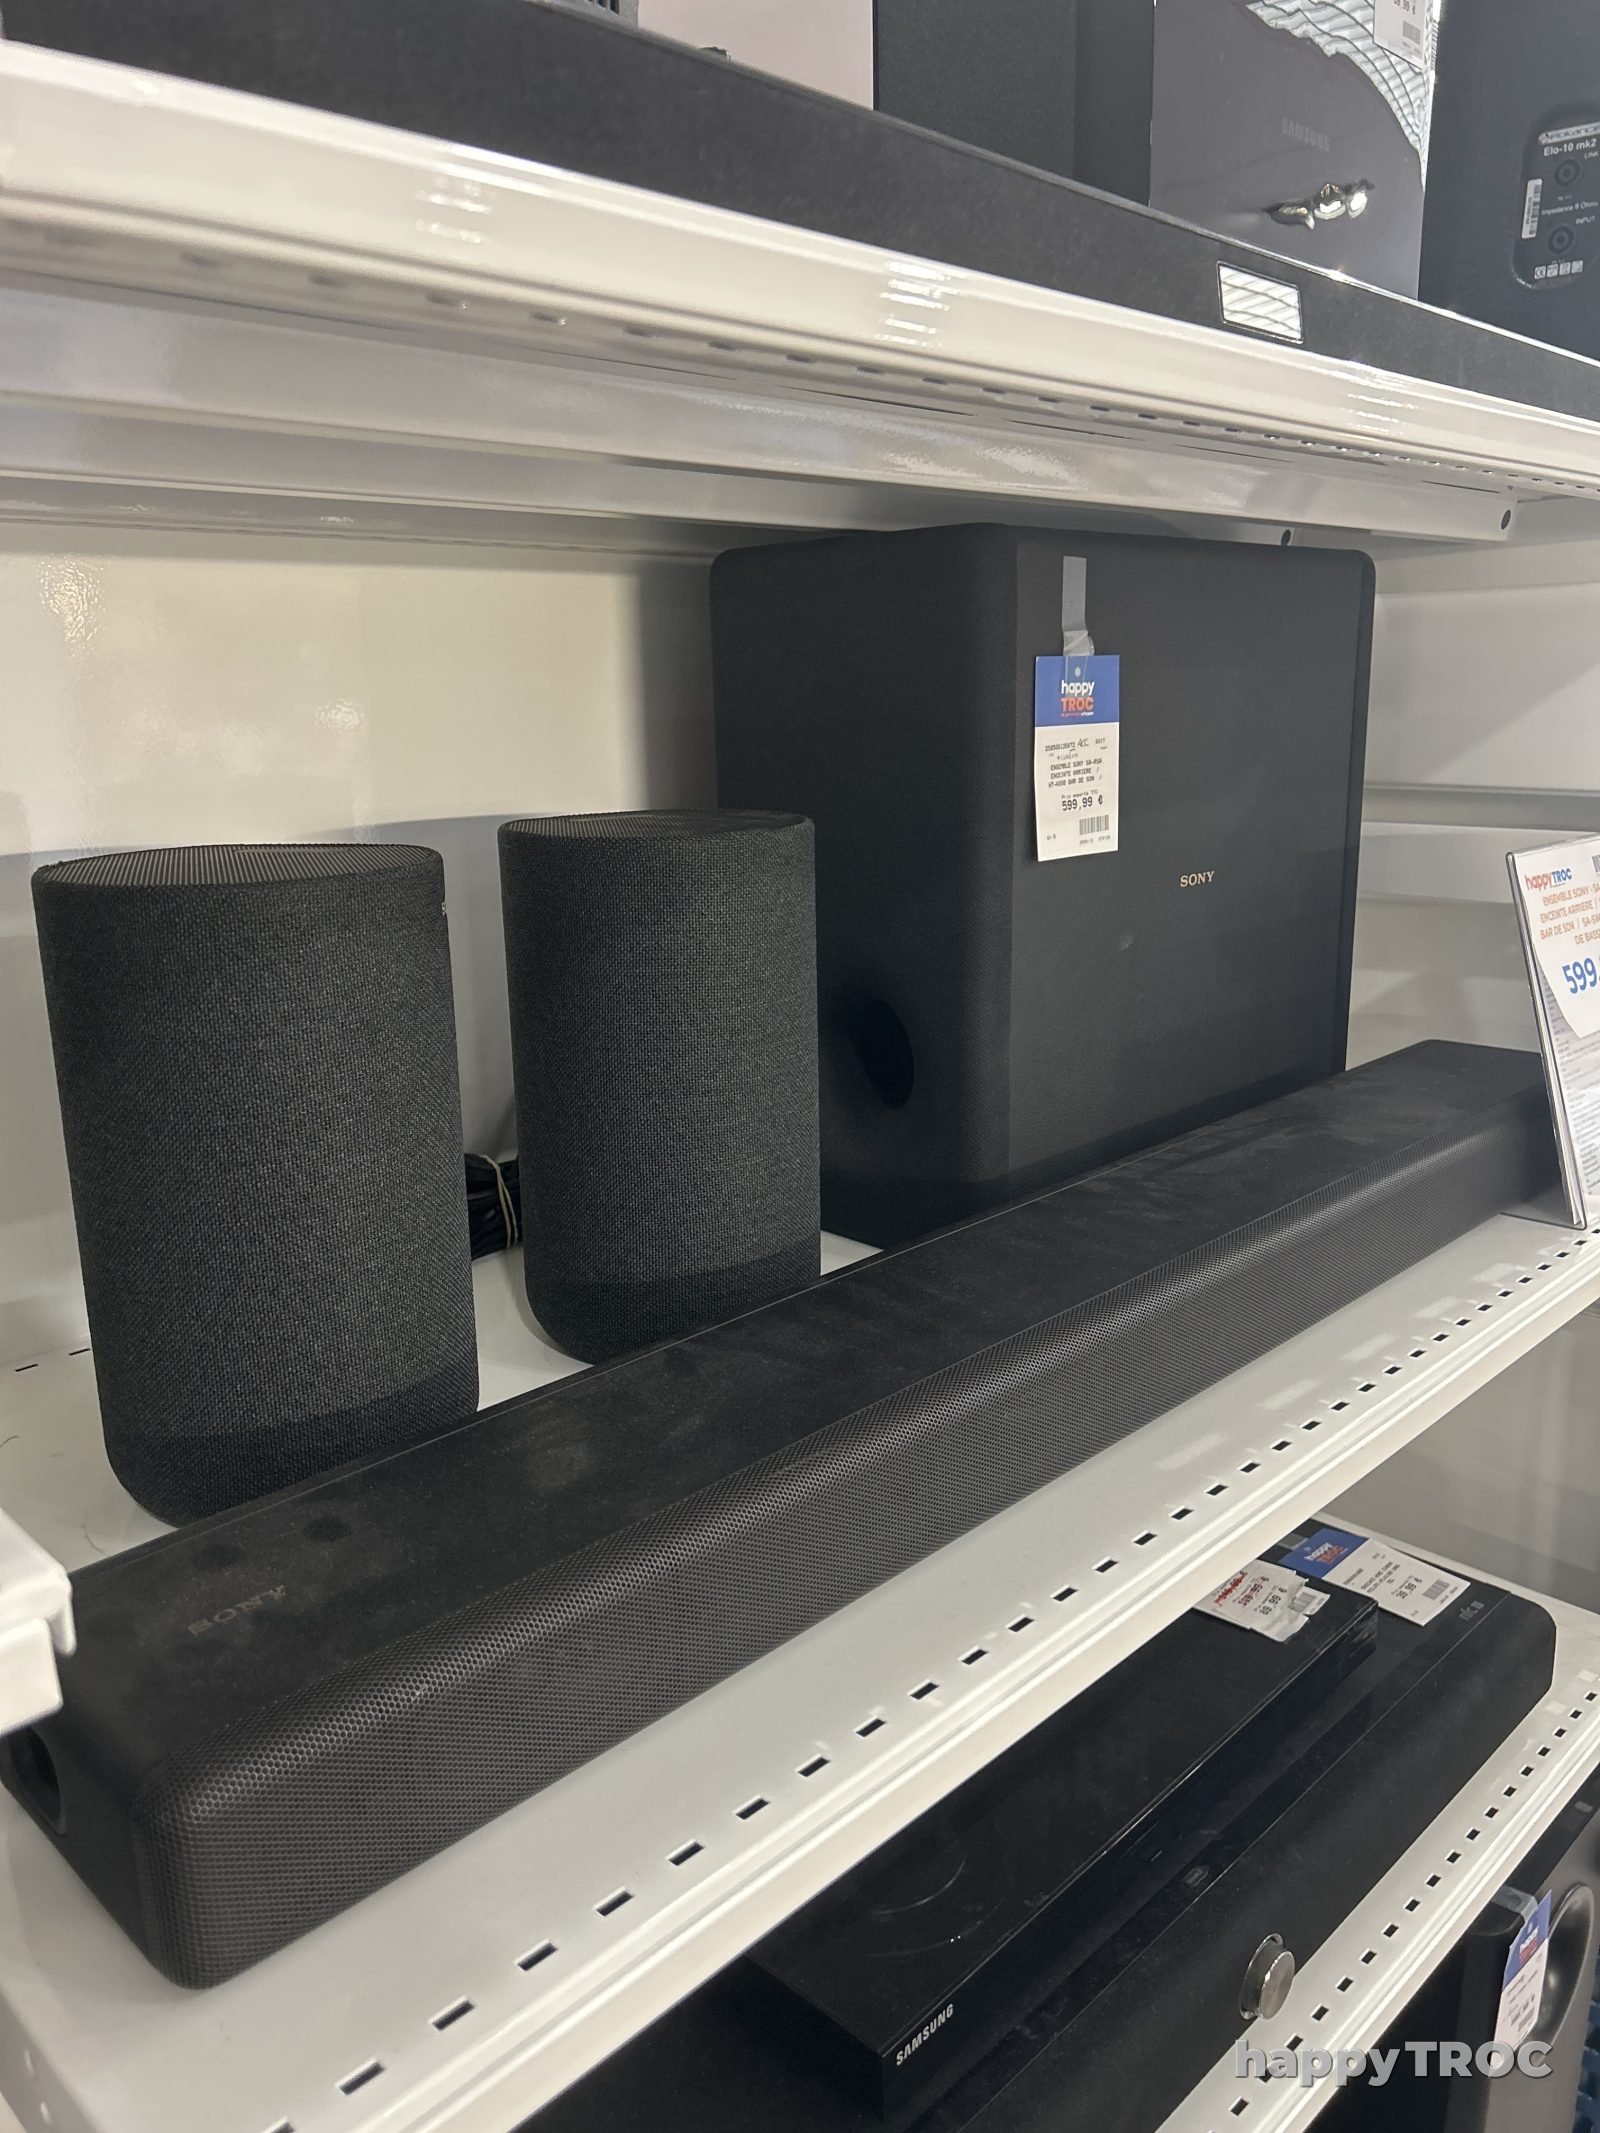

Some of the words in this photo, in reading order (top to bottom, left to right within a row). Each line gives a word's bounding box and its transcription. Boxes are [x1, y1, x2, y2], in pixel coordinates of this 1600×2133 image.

[1281, 117, 1331, 152] SAMSUNG
[1543, 142, 1574, 156] Elo-10
[1576, 138, 1598, 151] mk2
[1061, 680, 1096, 695] happy
[1061, 697, 1094, 712] TROC
[1061, 796, 1093, 811] 599,99
[1097, 794, 1103, 805] €
[1180, 870, 1216, 888] SONY
[1542, 890, 1573, 906] ENSEMBLE
[1573, 886, 1589, 898] SONY
[1540, 928, 1553, 940] BAR
[1554, 924, 1563, 936] DE
[1575, 934, 1585, 945] DE
[187, 1585, 286, 1637] SONY
[896, 2003, 955, 2067] SAMSUNG
